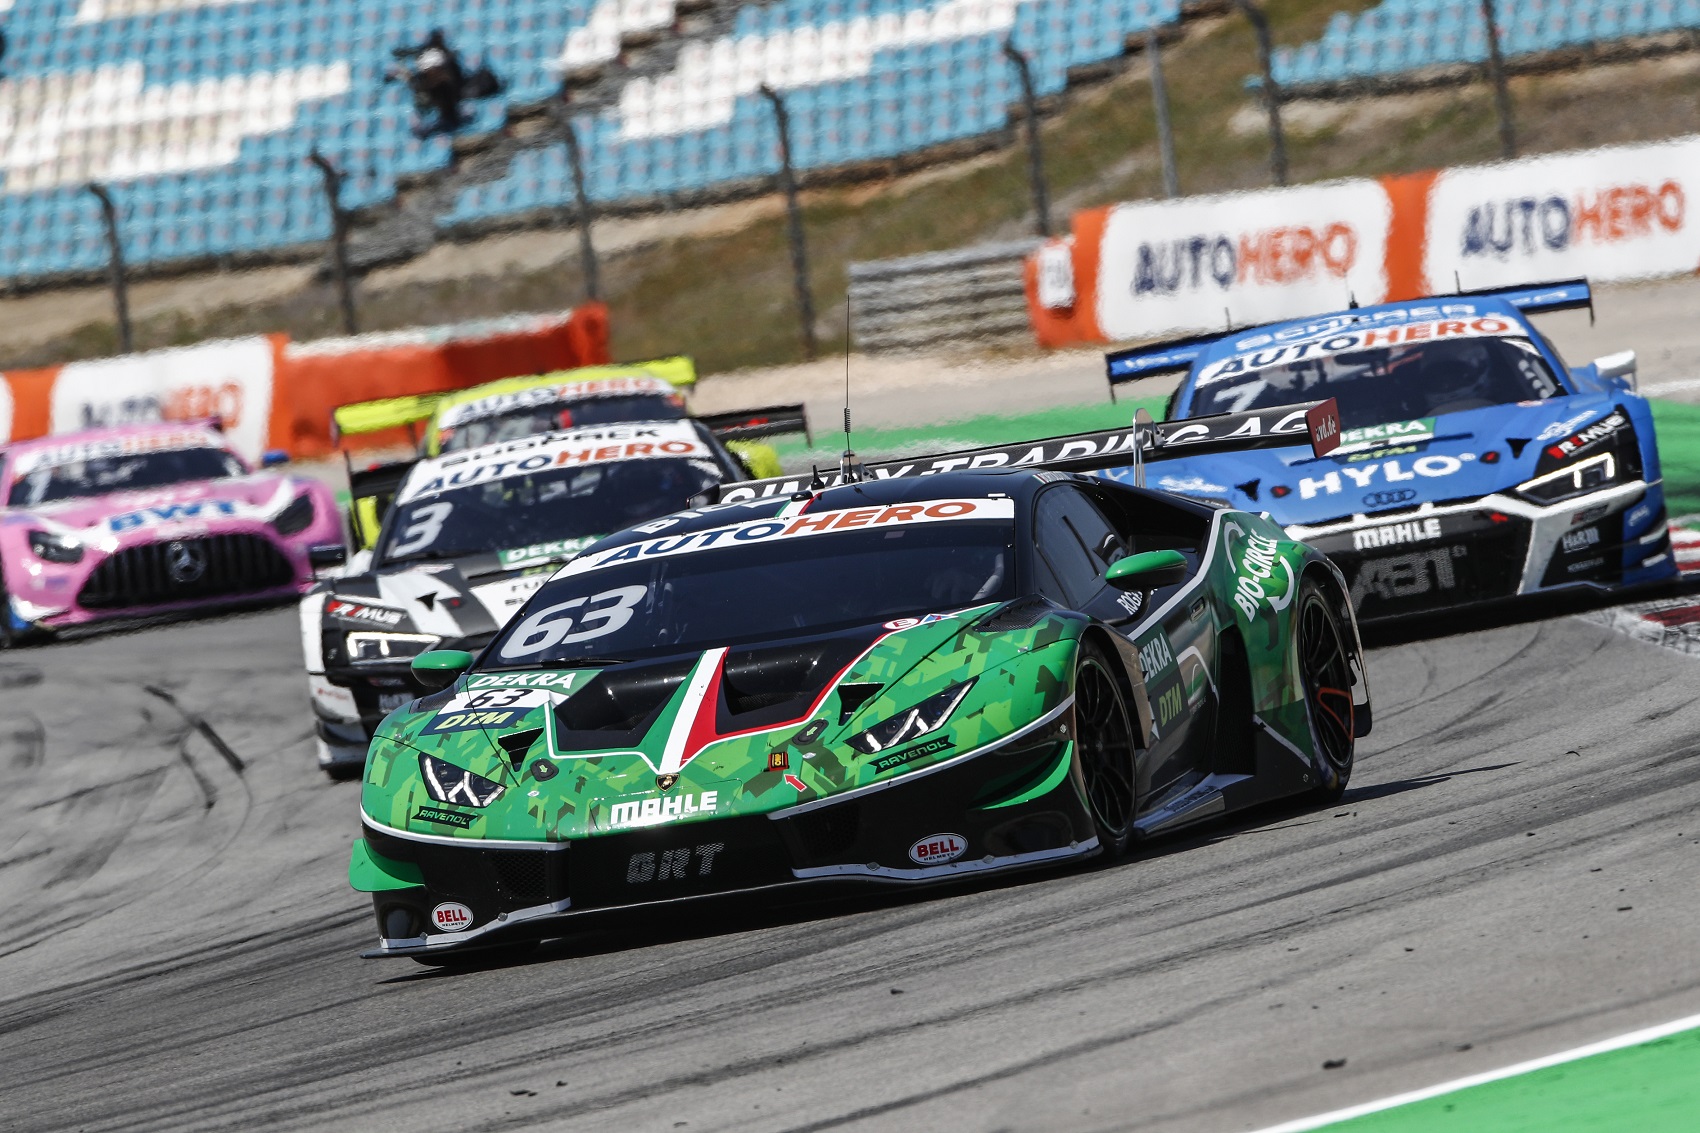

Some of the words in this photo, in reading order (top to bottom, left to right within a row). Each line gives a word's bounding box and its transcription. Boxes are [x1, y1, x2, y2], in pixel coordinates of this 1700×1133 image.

[1460, 178, 1687, 256] AUTOHERO
[1132, 222, 1358, 296] AUTOHERO
[1213, 319, 1508, 379] AUTOHERO
[1213, 377, 1268, 411] 7
[1559, 412, 1626, 454] REMUS
[412, 440, 695, 500] AUTOHERO
[388, 502, 454, 559] 3
[593, 501, 977, 568] AUTOHERO
[1353, 518, 1442, 551] MAHLE
[1234, 528, 1278, 623] BIO-CIRCLE
[1341, 548, 1456, 619] ABT
[500, 585, 648, 660] 63
[1139, 632, 1173, 684] DEKRA
[463, 688, 534, 709] 63
[467, 672, 577, 690] DEKRA
[434, 711, 515, 731] DTM
[1158, 683, 1183, 728] DTM
[878, 741, 947, 769] RAVENOL
[419, 809, 471, 825] RAVENOL
[610, 791, 718, 826] MAHLE
[626, 842, 725, 884] GRT
[917, 838, 960, 859] BELL
[436, 909, 468, 923] BELL
